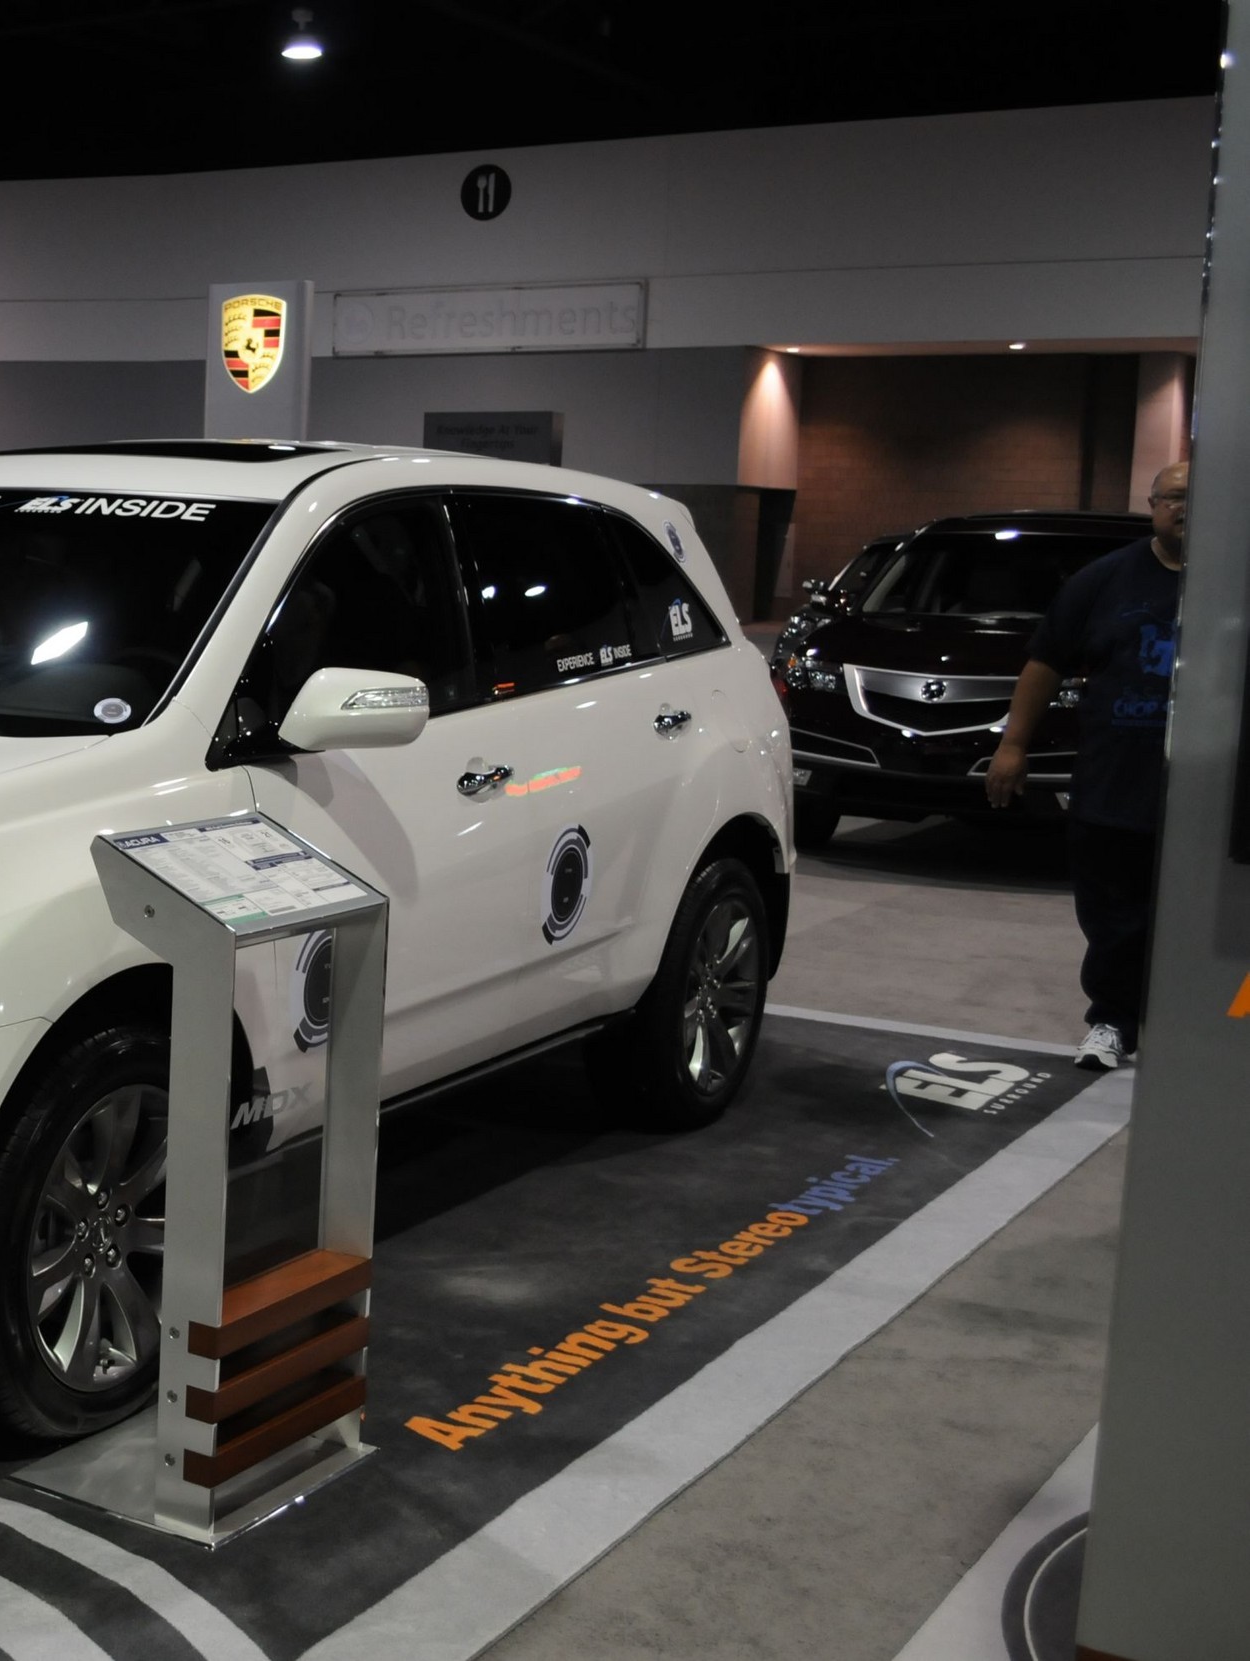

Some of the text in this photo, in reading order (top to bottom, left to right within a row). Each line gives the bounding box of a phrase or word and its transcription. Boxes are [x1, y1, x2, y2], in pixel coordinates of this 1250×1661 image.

[224, 298, 282, 312] PORSCHE
[387, 301, 637, 340] Refreshments
[74, 497, 217, 522] INSIDE
[669, 603, 693, 636] ELS
[556, 652, 595, 672] EXPERIENCE
[613, 644, 632, 660] INSIDE
[124, 836, 161, 848] ACURA
[879, 1052, 1030, 1110] ELS
[983, 1072, 1052, 1115] SURROUND
[230, 1081, 314, 1131] MDX
[404, 1319, 649, 1450] Anything
[600, 1278, 706, 1322] but
